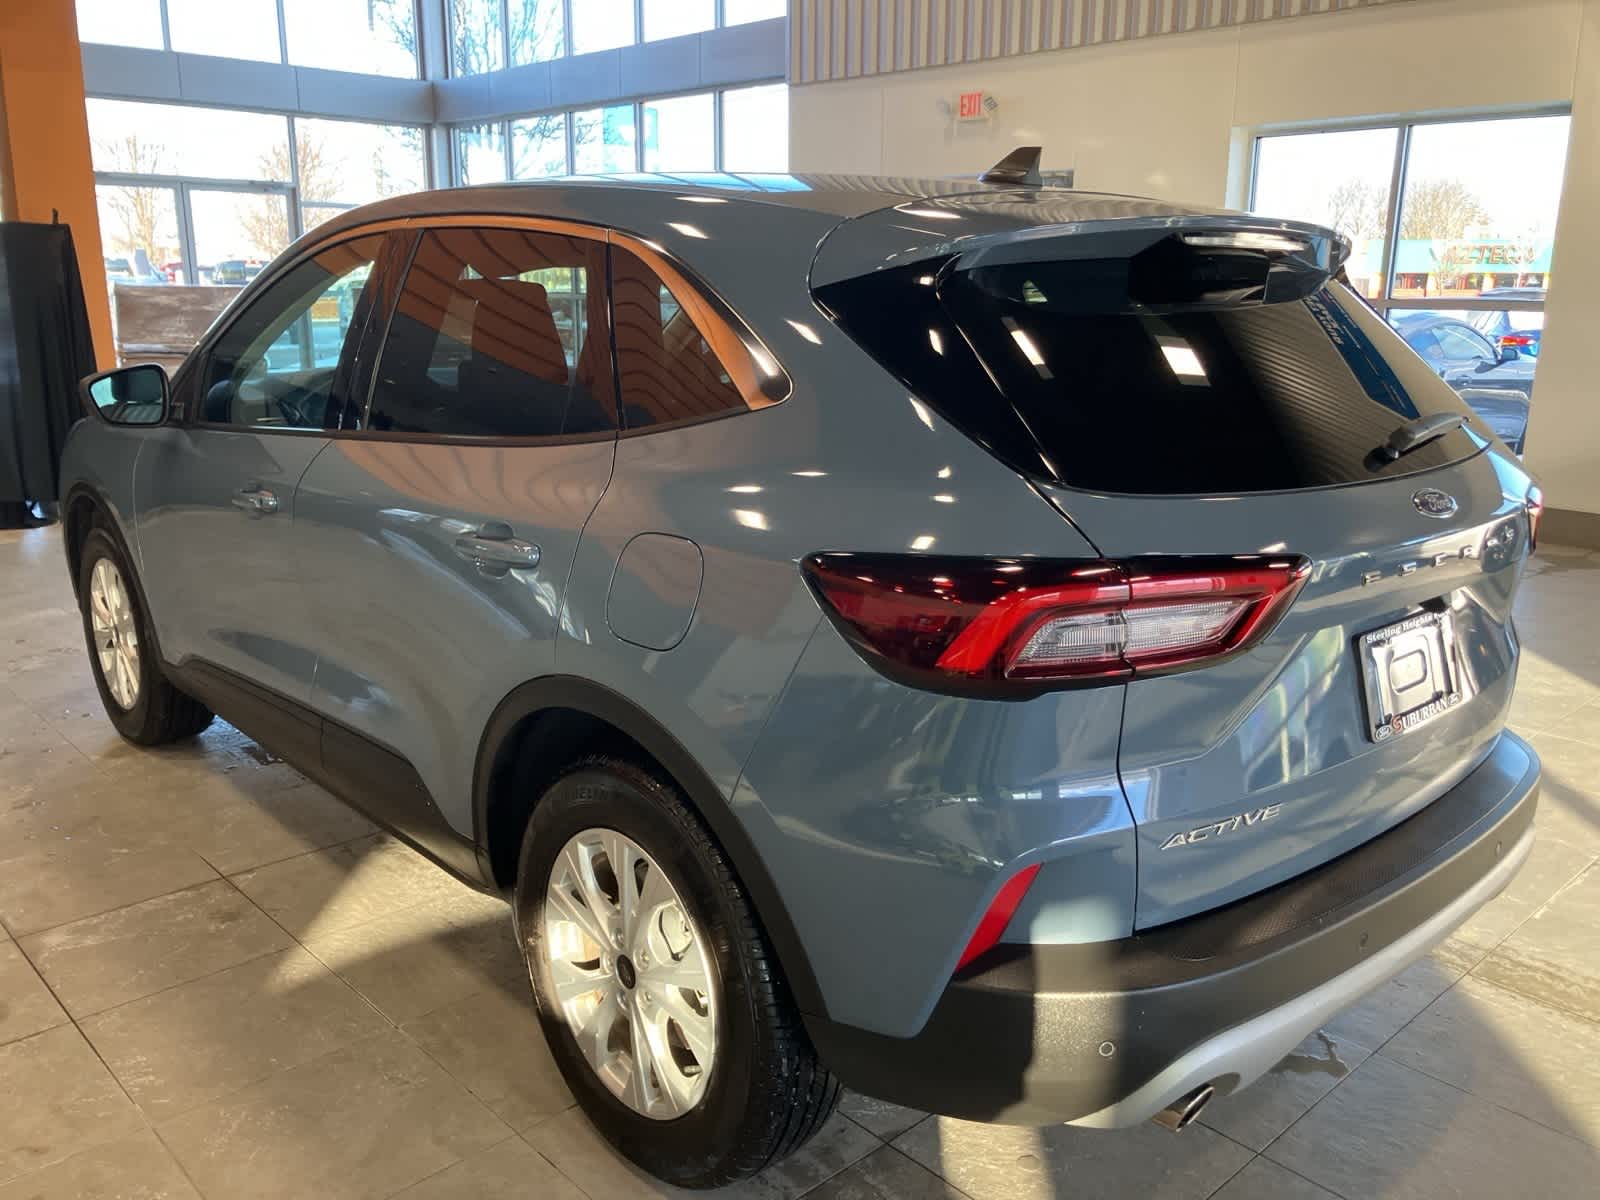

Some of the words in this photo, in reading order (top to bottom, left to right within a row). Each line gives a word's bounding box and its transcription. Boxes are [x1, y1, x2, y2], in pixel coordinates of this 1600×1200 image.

[960, 92, 983, 118] EXIT
[1366, 625, 1401, 644] Sterling
[1402, 613, 1434, 632] Heights
[1391, 696, 1449, 734] SUBURBAN
[1158, 801, 1285, 851] ACTIVE
